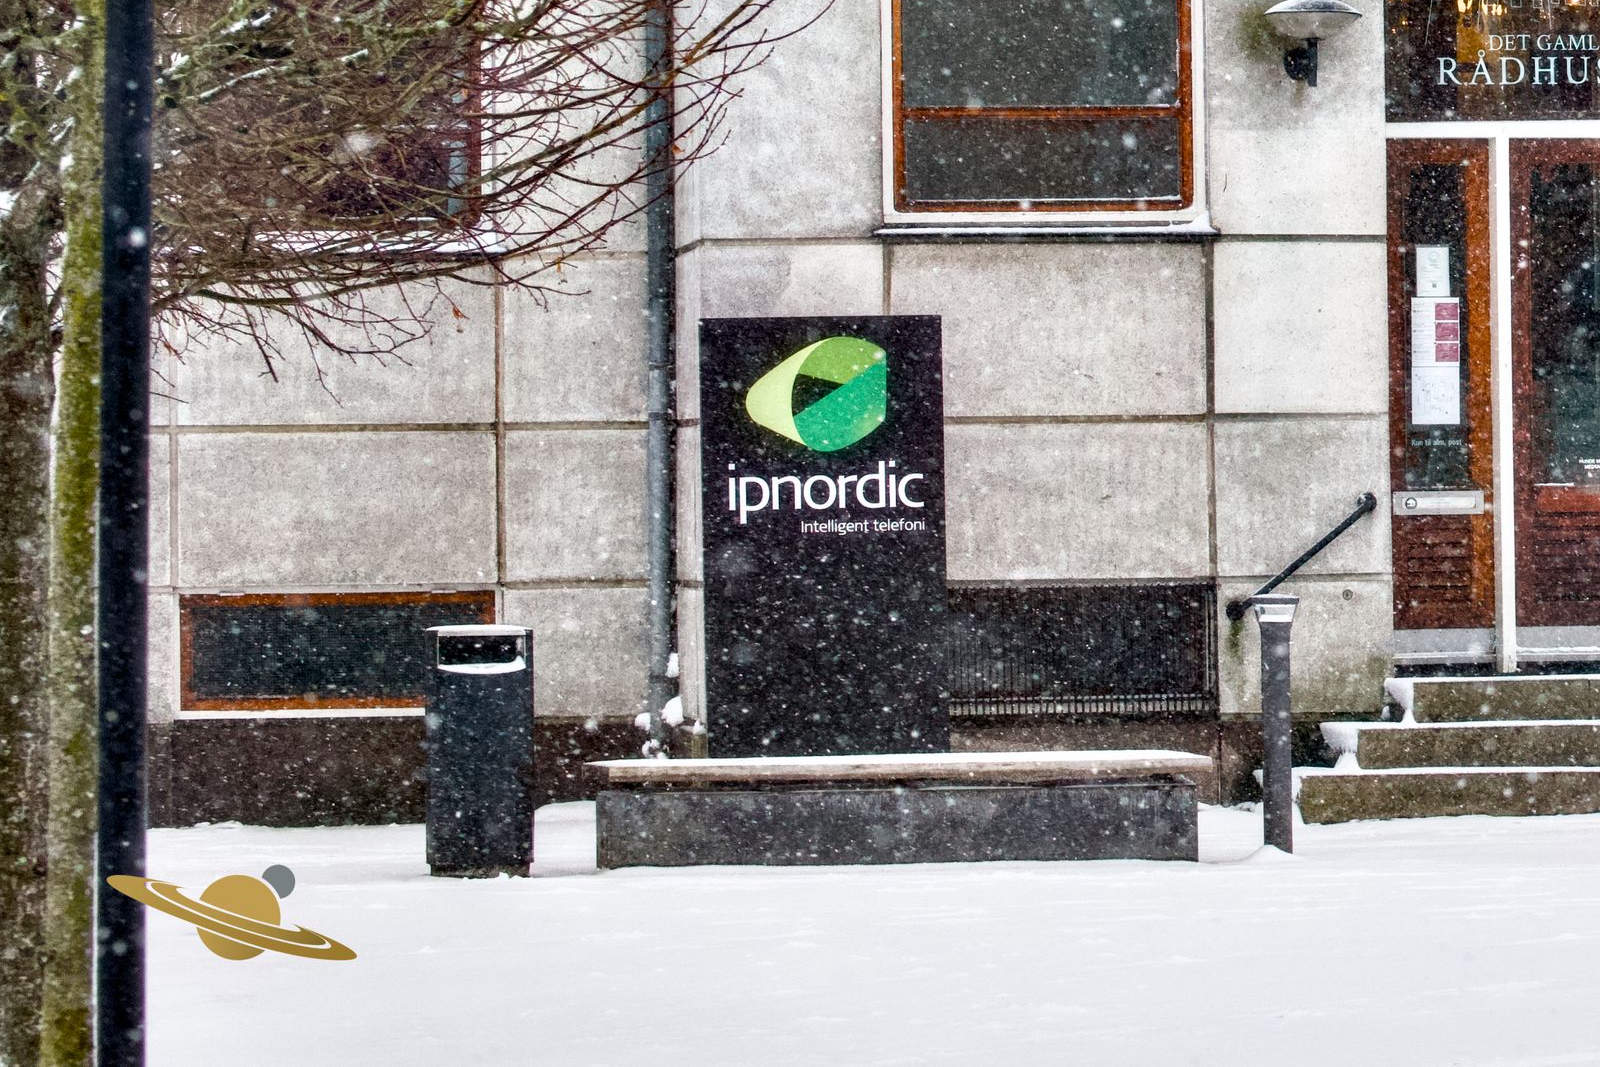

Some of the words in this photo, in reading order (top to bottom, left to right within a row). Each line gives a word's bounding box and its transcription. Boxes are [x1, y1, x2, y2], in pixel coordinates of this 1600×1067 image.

[1487, 34, 1534, 52] DET
[728, 460, 925, 525] ipnordic
[801, 520, 869, 536] Intelligent
[873, 517, 926, 533] telefoni
